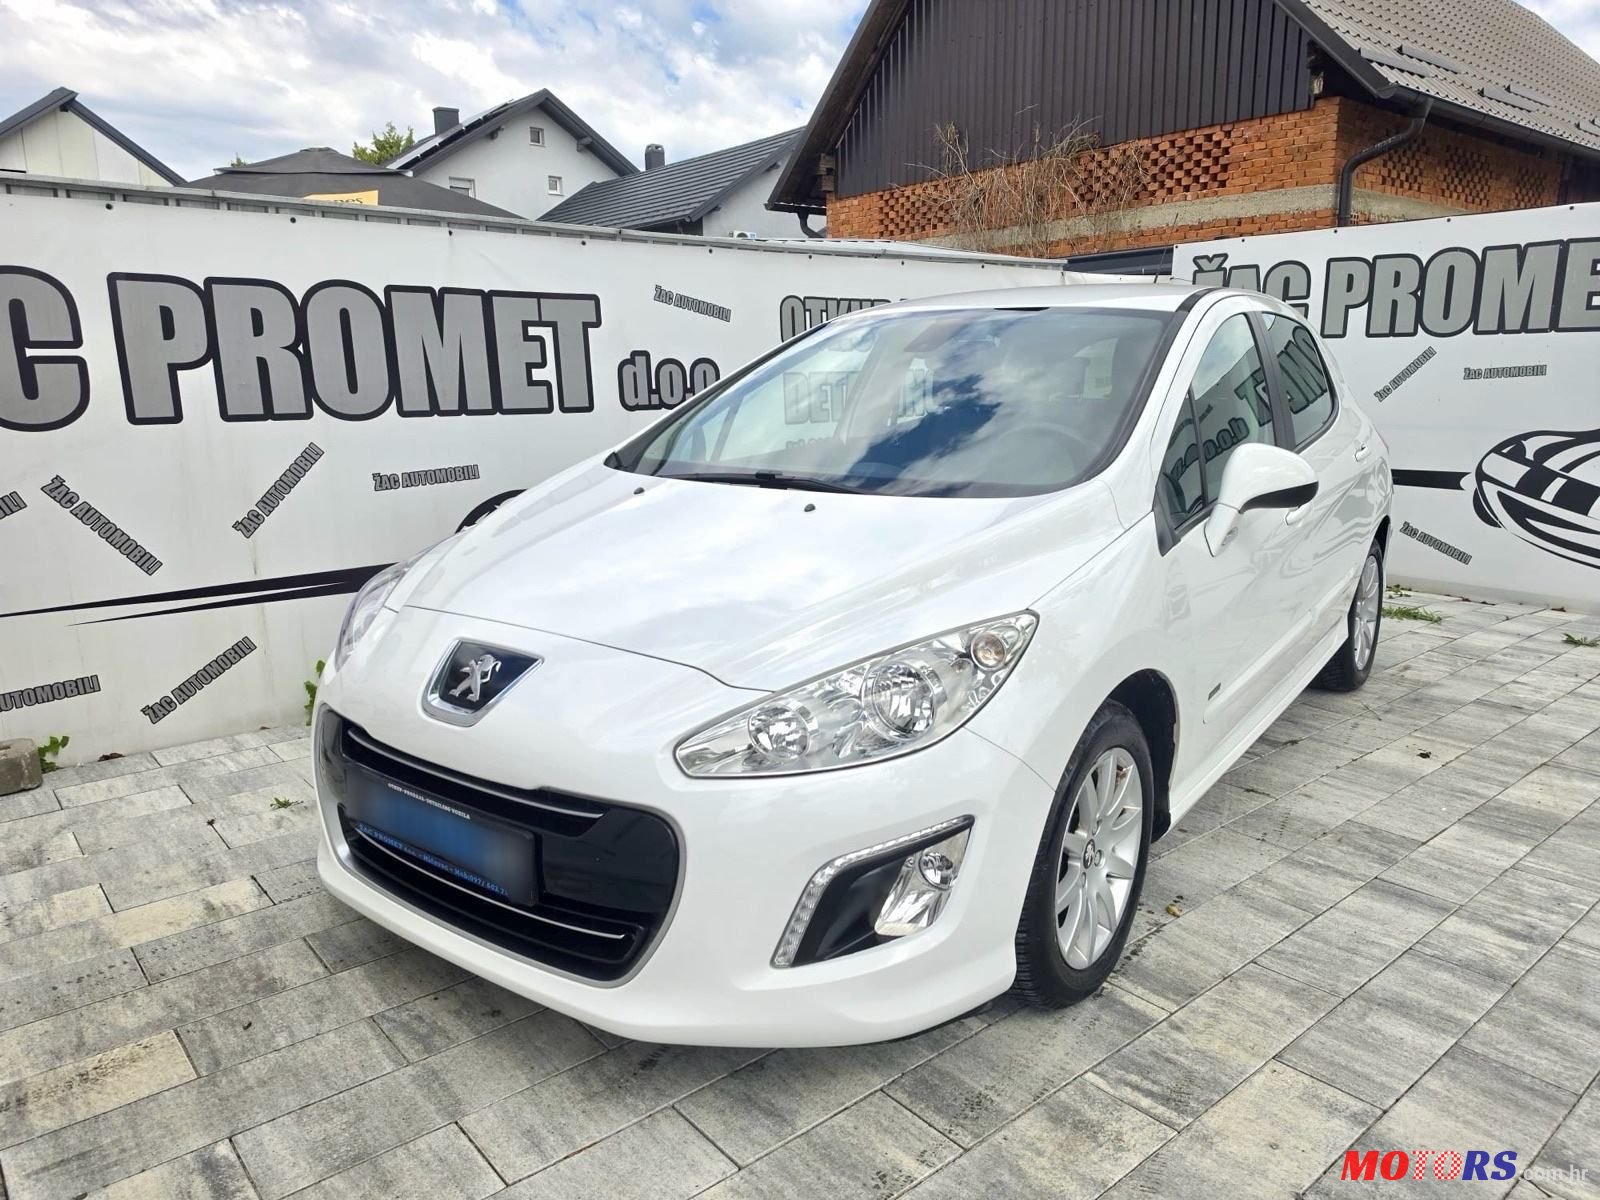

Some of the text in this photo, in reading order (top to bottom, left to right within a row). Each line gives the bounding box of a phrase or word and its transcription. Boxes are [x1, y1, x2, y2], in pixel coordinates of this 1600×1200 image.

[653, 283, 732, 323] ŽAC AUTOMOBILI
[1320, 236, 1600, 339] PROME
[0, 264, 91, 433] C
[106, 271, 602, 426] PROMET
[1388, 345, 1438, 391] AUTOMOBILI
[1483, 364, 1548, 380] AUTOMOBILI
[231, 441, 325, 539] ŽAC AUTOMOBILI
[371, 464, 480, 492] ŽAC AUTOMOBILI
[40, 474, 164, 576] ŽAC AUTOMOBILI
[1415, 530, 1473, 566] AUTOMOBILI
[0, 674, 102, 712] UTOMOBILI
[140, 635, 258, 725] ŽAC AUTOMOBILI
